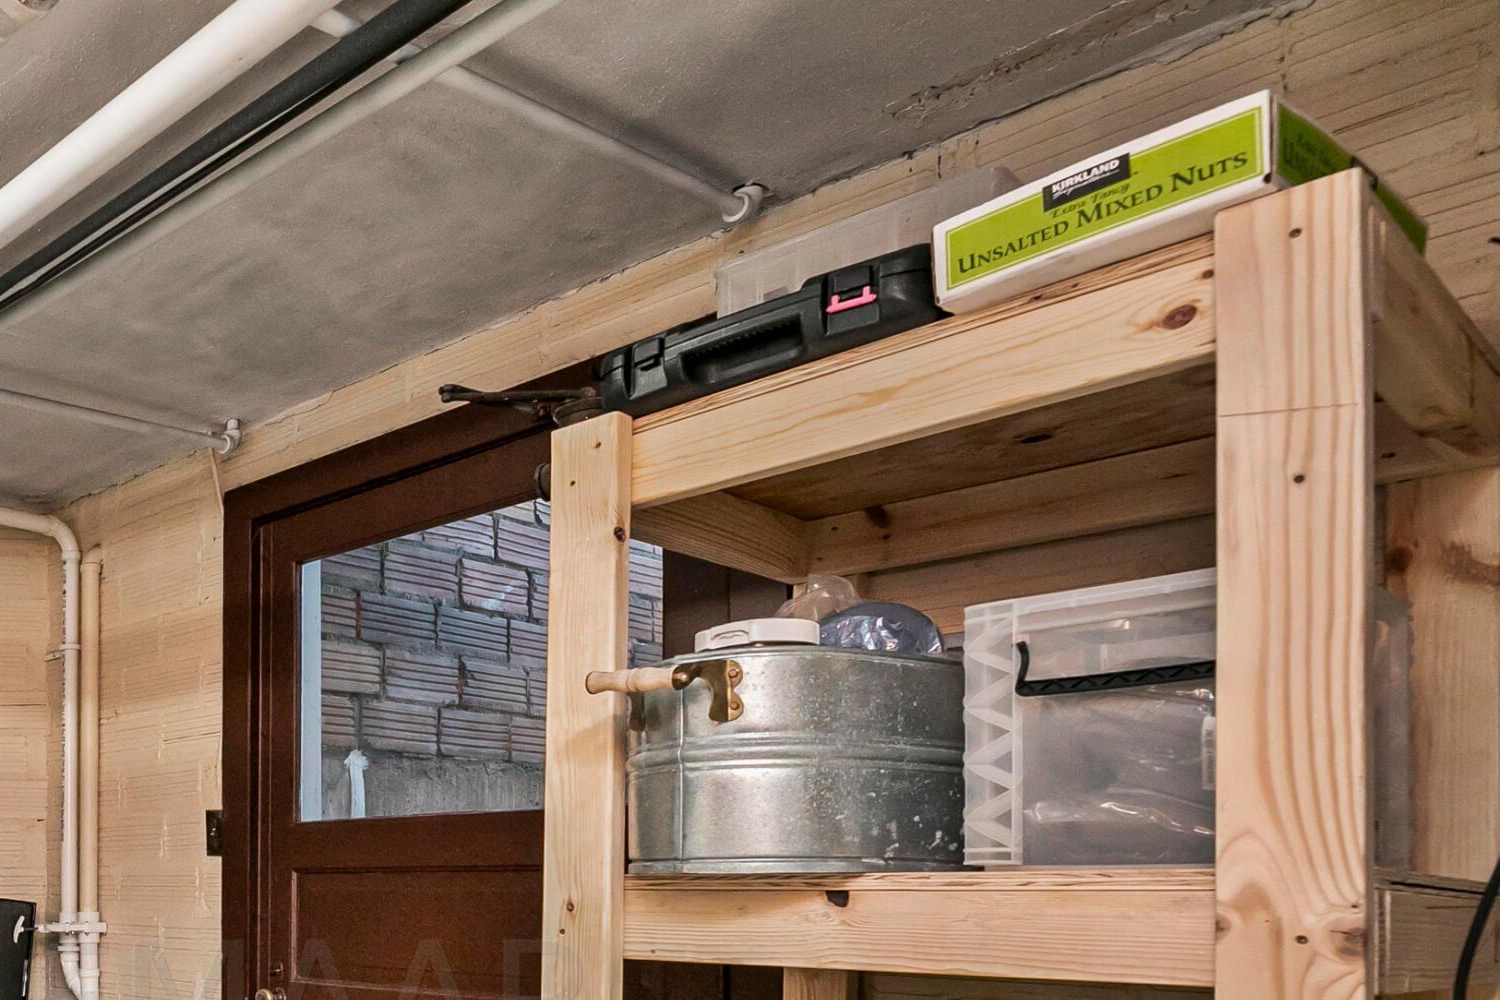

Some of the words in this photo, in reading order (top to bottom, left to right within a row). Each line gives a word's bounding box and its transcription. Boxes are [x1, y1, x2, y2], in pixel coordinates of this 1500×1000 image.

[957, 220, 1069, 274] UNSALTED
[1077, 183, 1163, 229] MIXED
[1170, 151, 1249, 193] NUTS
[1051, 159, 1120, 193] KIRKLAND
